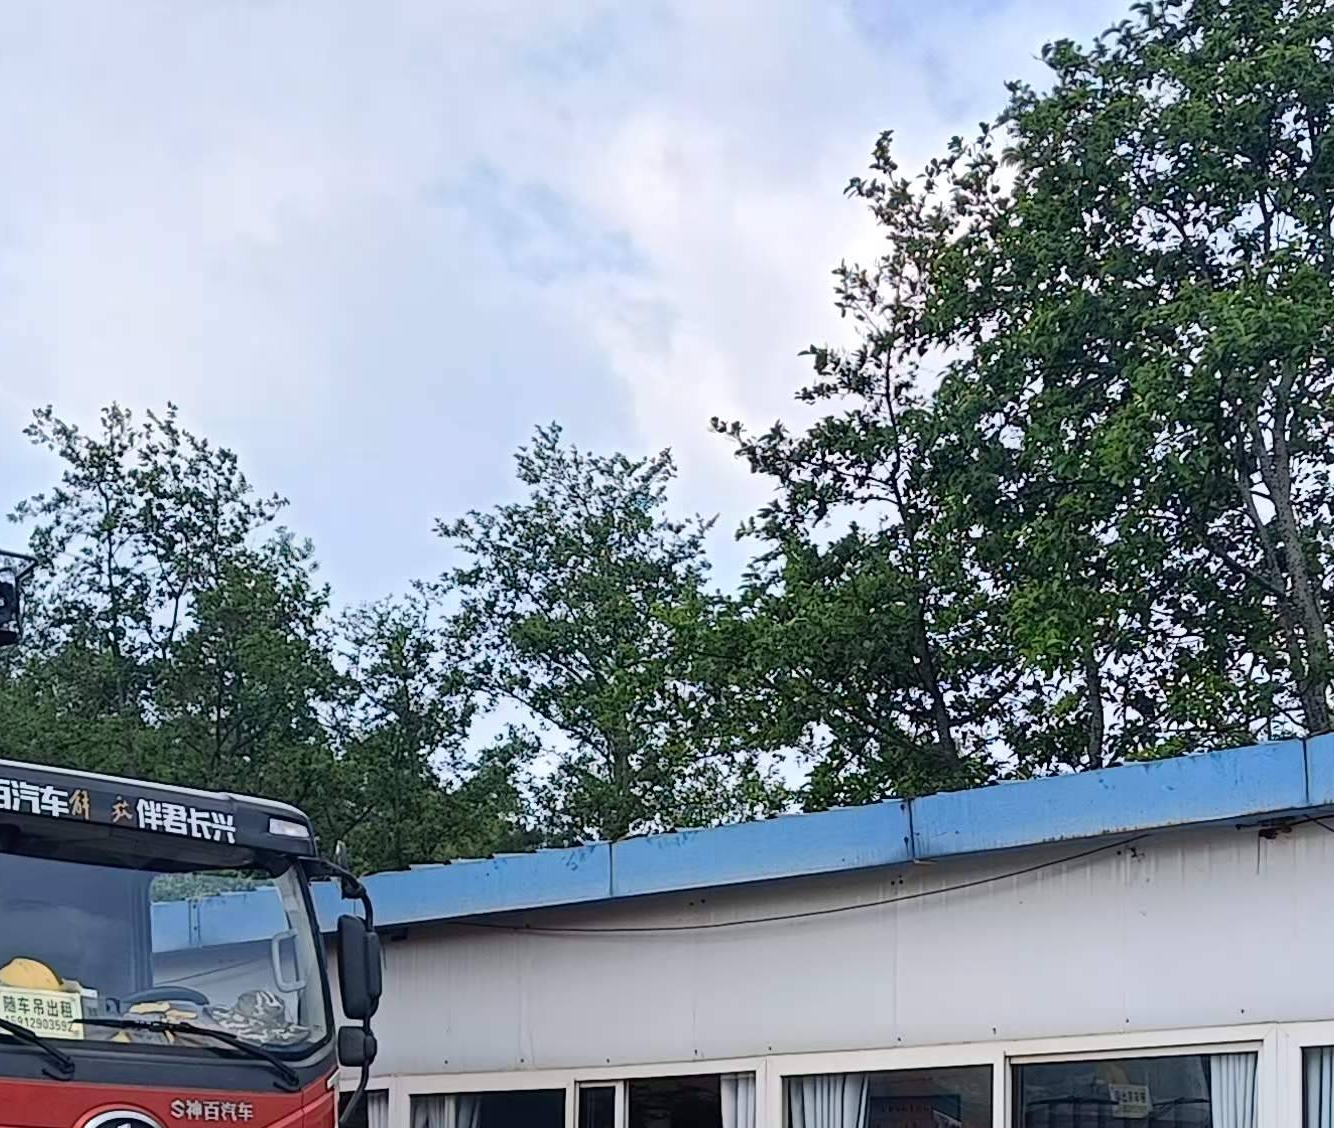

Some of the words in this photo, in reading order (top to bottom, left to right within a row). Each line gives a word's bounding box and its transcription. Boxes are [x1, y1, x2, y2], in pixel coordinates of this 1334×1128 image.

[137, 798, 236, 843] 伴君长兴
[3, 995, 73, 1018] 随车吊出租
[5, 1015, 75, 1033] 5912903592
